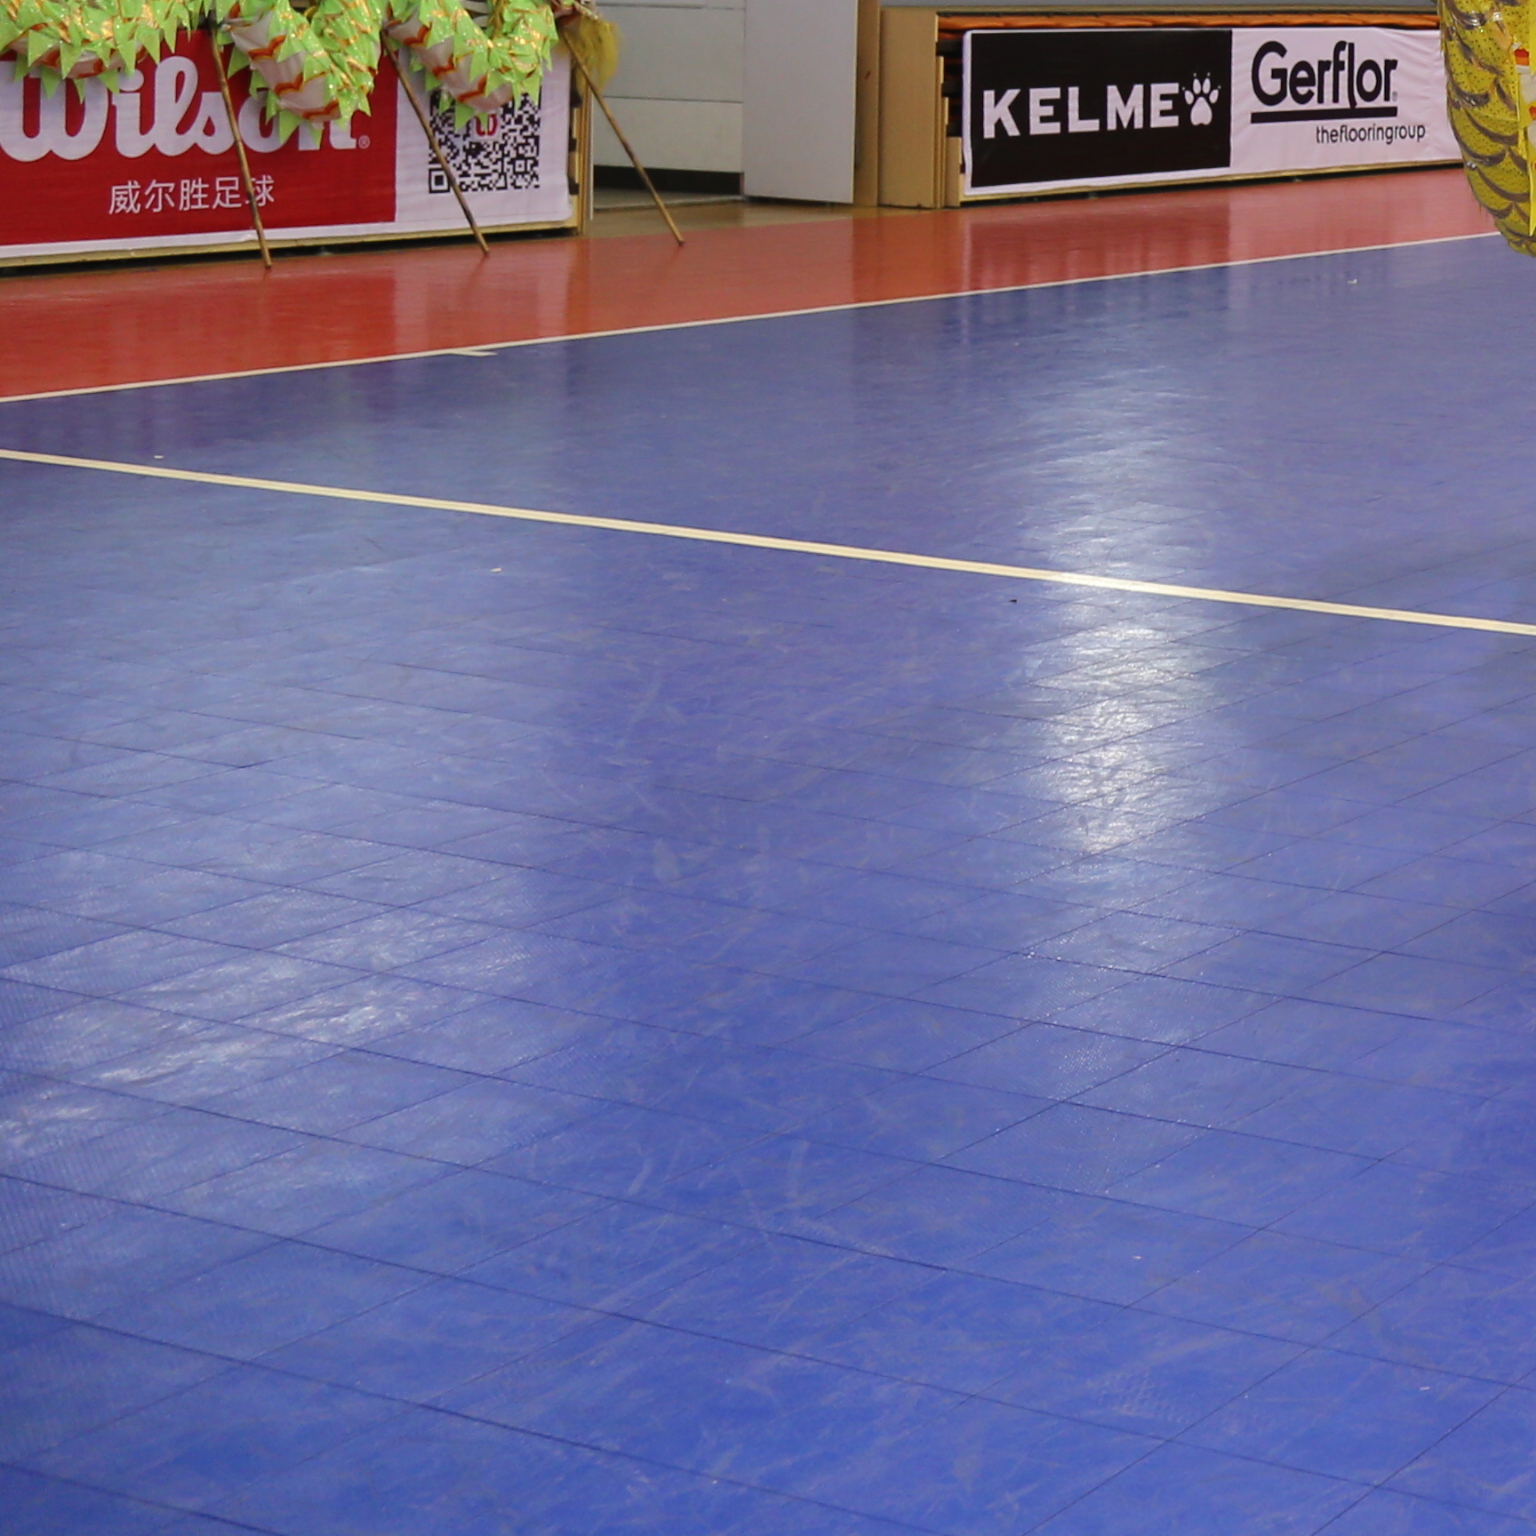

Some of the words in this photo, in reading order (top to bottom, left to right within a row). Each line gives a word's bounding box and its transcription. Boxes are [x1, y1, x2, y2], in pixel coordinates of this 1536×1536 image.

[1251, 40, 1398, 109] Gerflor
[983, 82, 1179, 139] KELME
[1316, 123, 1426, 145] theflooringroup
[108, 175, 275, 215] 威尔胜足球
